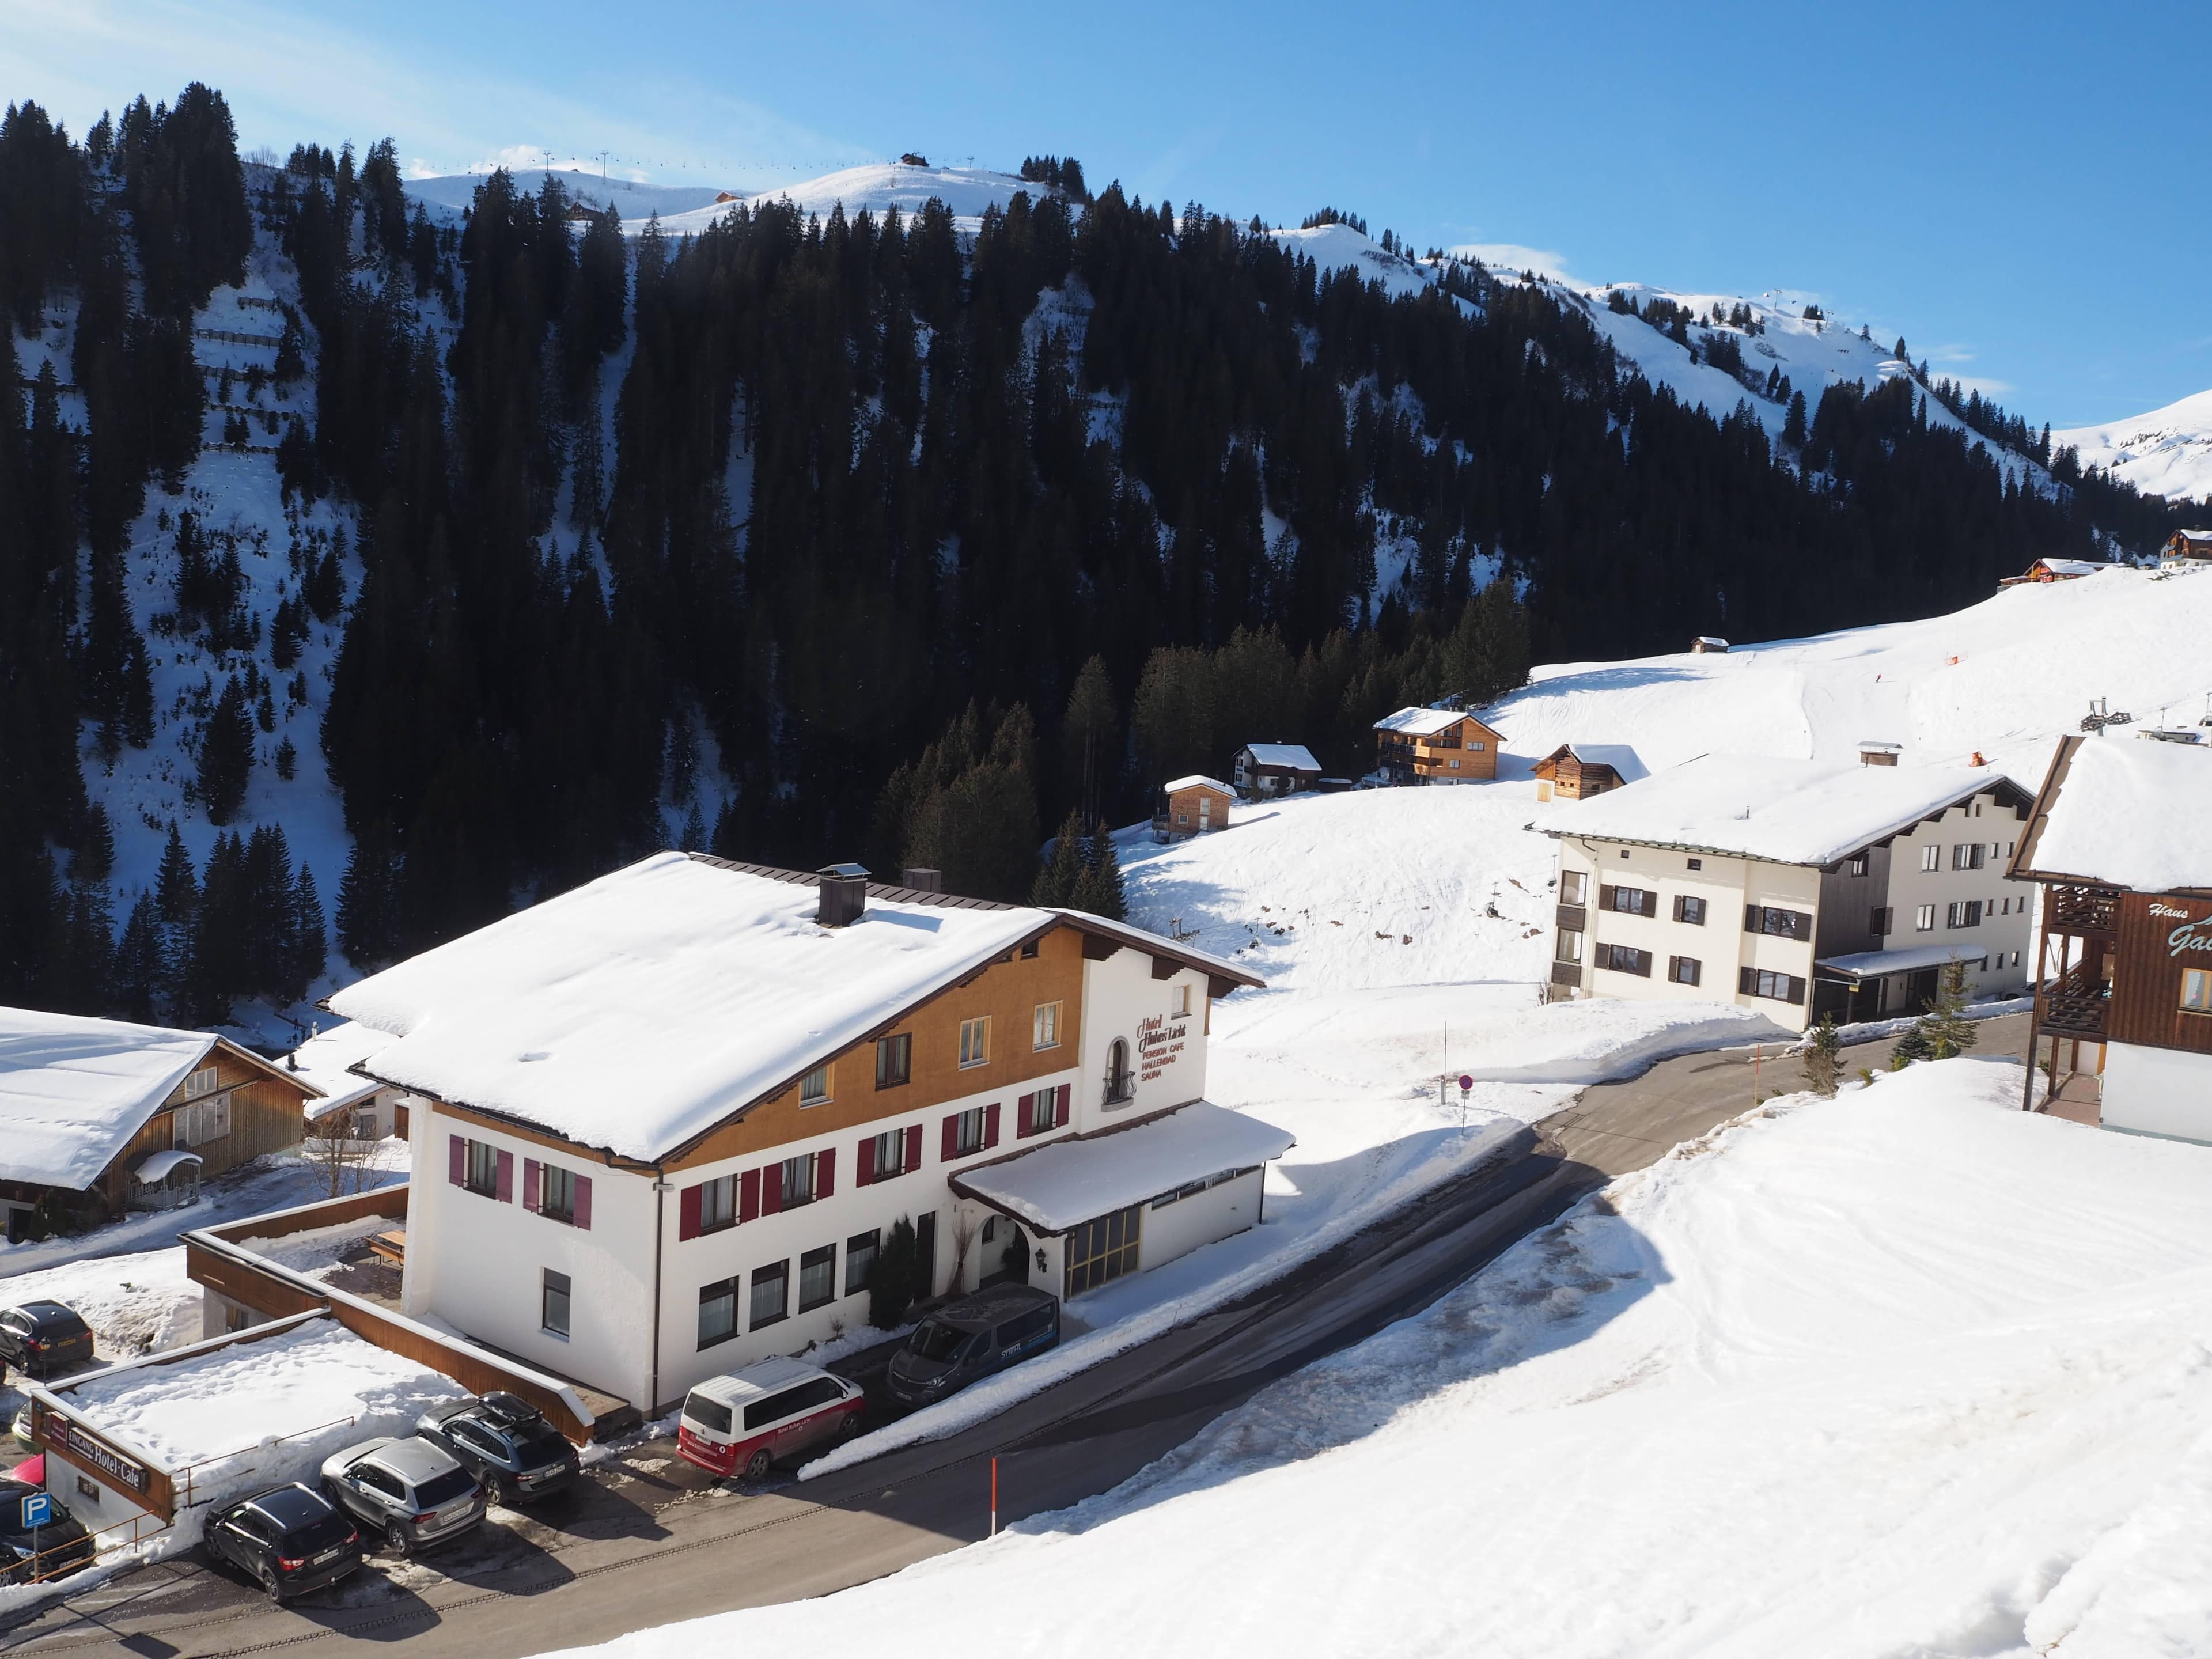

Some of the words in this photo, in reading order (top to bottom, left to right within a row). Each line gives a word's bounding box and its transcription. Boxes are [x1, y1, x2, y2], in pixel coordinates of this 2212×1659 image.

[2149, 903, 2189, 918] Haus
[1137, 1014, 1162, 1039] Hotel
[1143, 1046, 1167, 1060] PENSION
[1142, 1055, 1176, 1071] HALLENBAD
[1141, 1069, 1162, 1081] SAUNA
[69, 1431, 94, 1453] EINGANG
[28, 1497, 47, 1520] P
